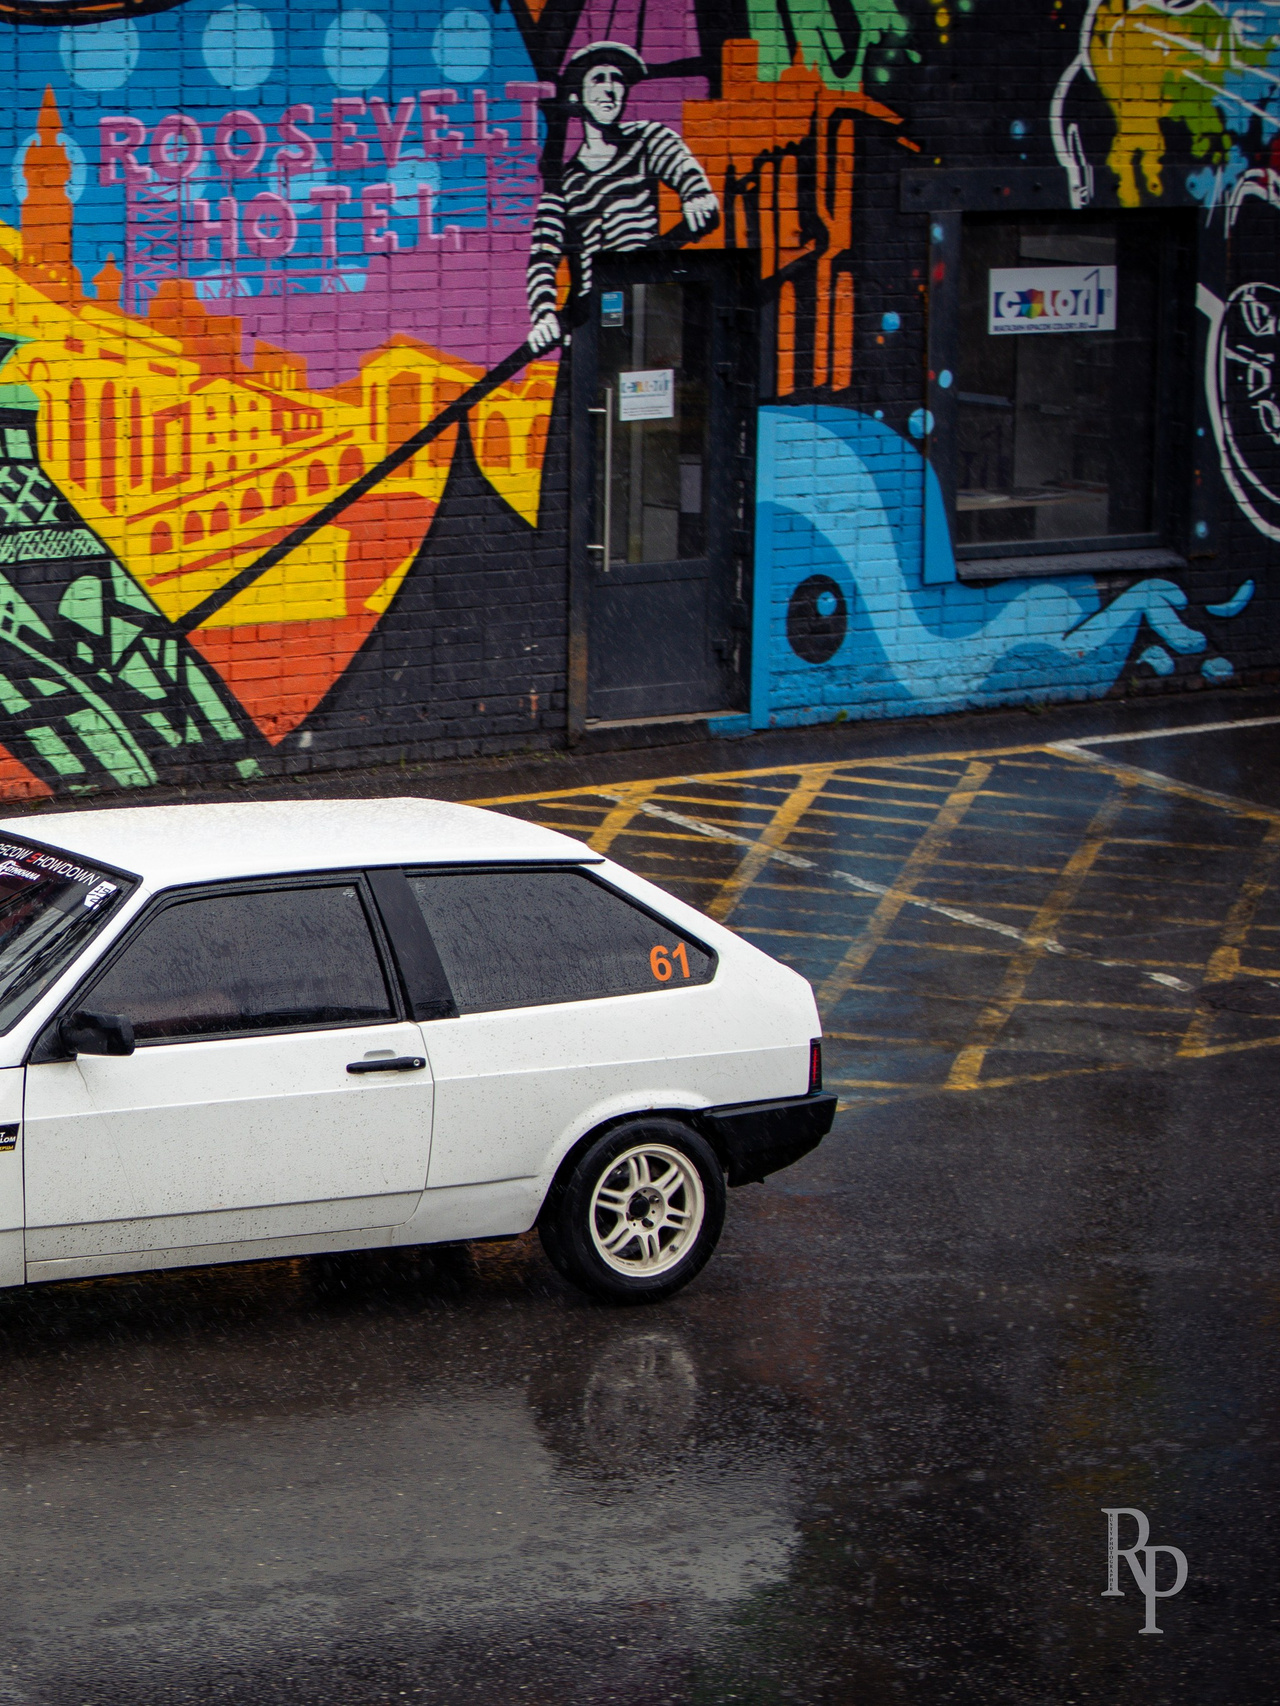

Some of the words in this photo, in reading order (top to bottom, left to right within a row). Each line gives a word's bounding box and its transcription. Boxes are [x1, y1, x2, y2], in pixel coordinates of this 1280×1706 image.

[98, 81, 557, 187] ROOSEVELT
[192, 183, 462, 260] HOTEL
[26, 852, 100, 886] SHOWDOWN
[650, 942, 690, 982] 61
